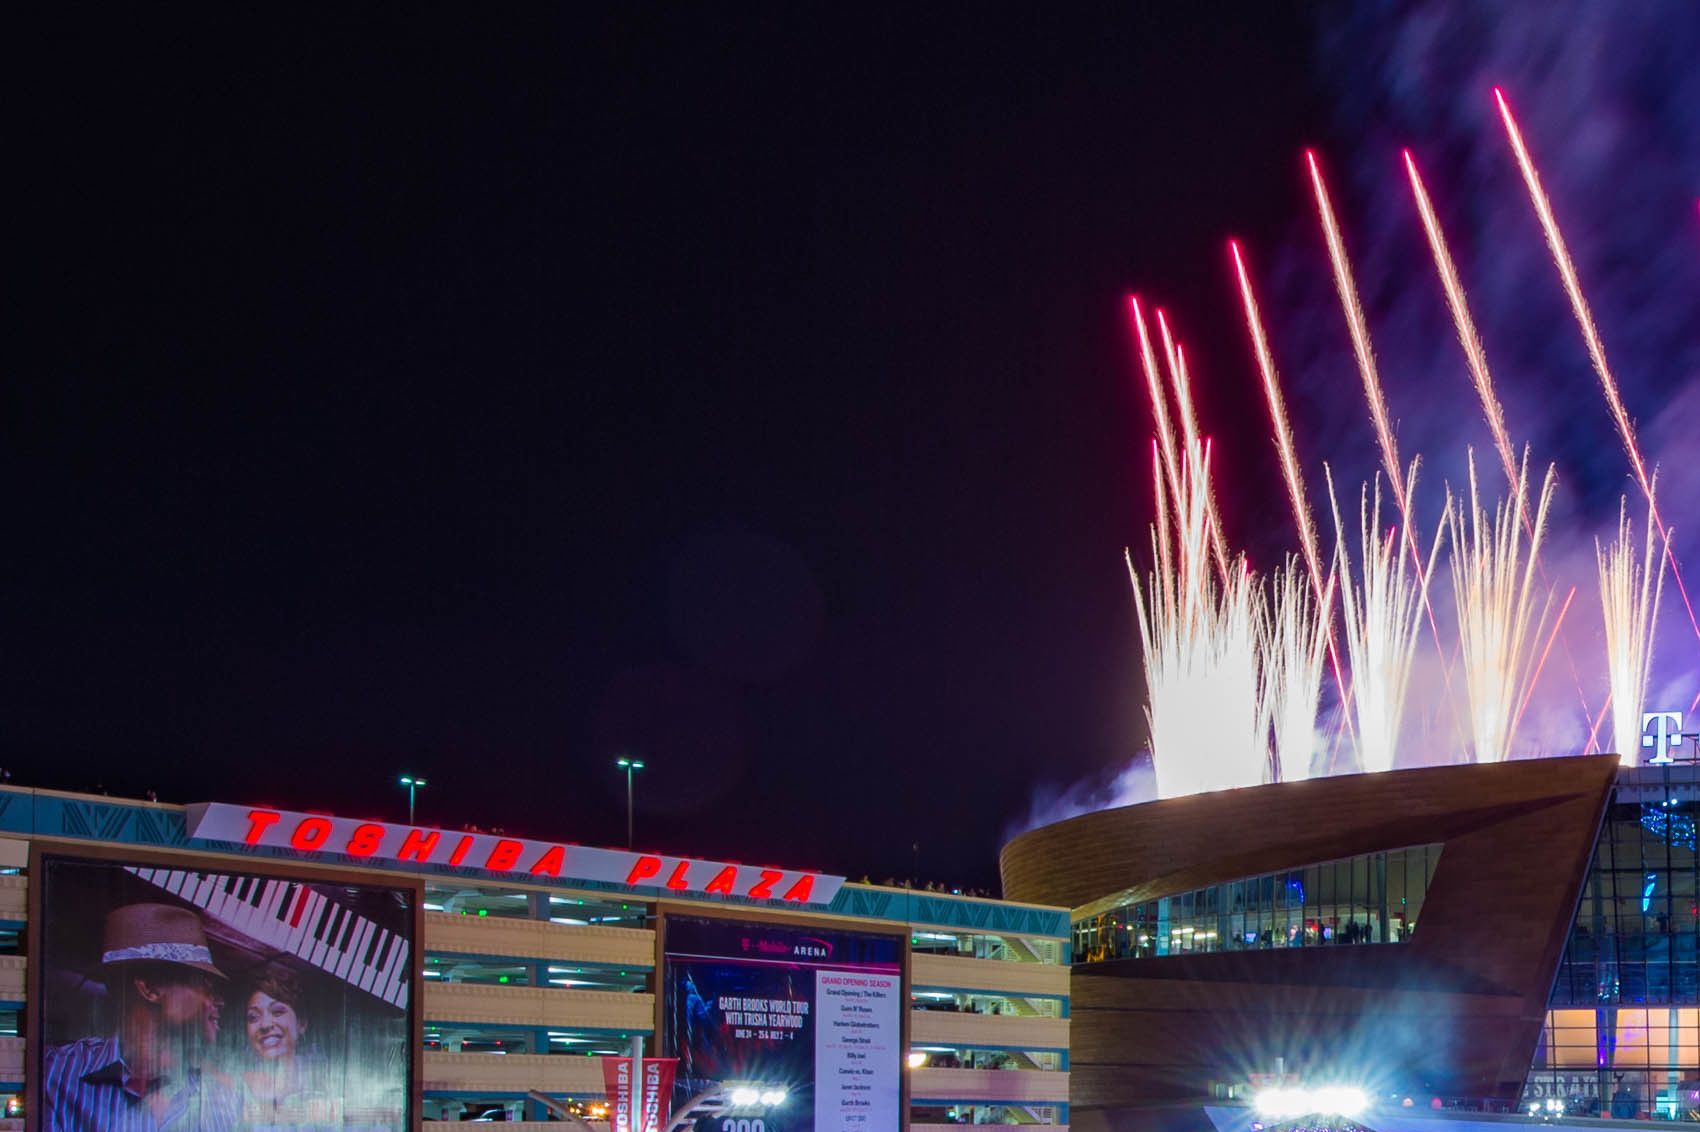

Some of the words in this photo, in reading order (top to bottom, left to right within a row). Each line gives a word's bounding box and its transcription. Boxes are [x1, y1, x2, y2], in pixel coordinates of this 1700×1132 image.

[243, 810, 566, 878] TOSHIBA
[625, 855, 817, 904] PLAZA
[793, 945, 826, 957] ARENA
[719, 996, 741, 1010] GARTH
[742, 998, 768, 1012] BROOKS
[769, 1000, 792, 1014] WORLD
[791, 1001, 809, 1015] TOUR
[725, 1011, 742, 1025] WITH
[744, 1013, 768, 1026] TRISHA
[768, 1014, 803, 1029] YEARWOOD
